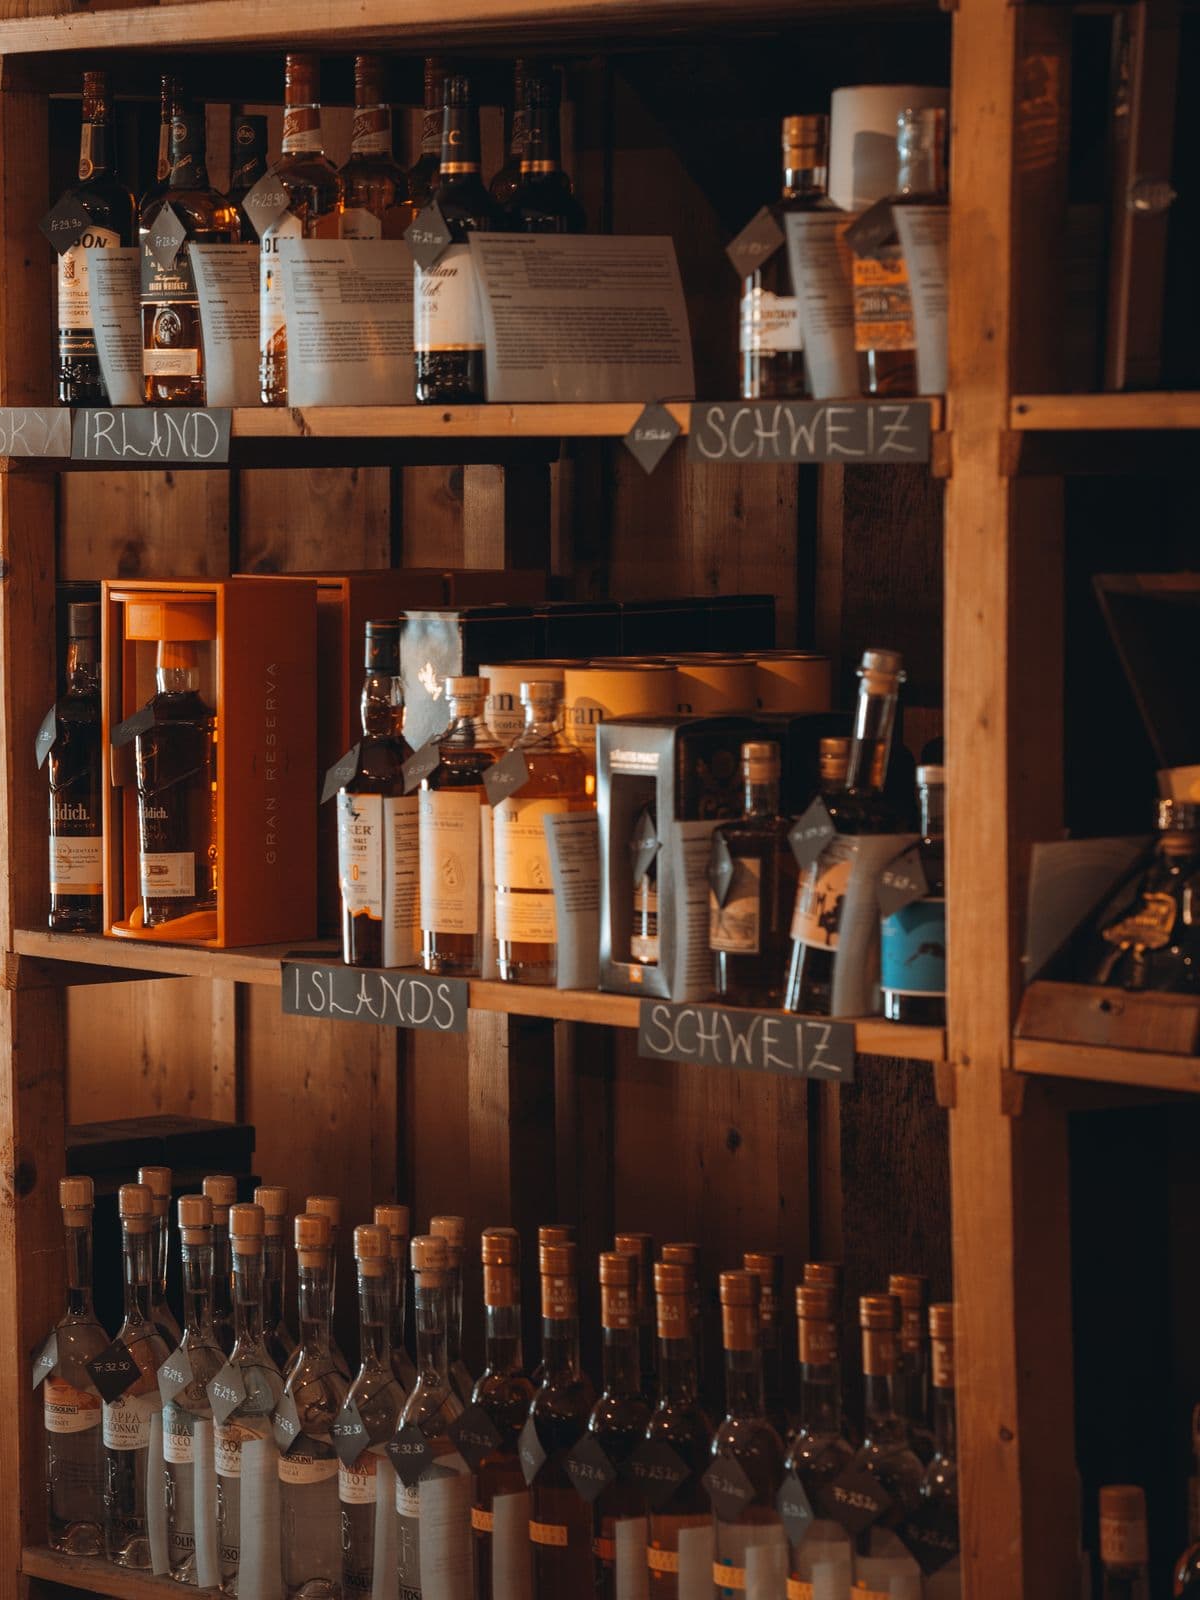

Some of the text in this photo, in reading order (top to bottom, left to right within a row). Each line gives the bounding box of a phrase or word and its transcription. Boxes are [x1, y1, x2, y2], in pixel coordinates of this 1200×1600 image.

[85, 410, 219, 458] IRLAND
[696, 404, 917, 459] SCHWEIZ
[266, 663, 277, 864] GRAN RESERVA
[294, 967, 455, 1030] ISLANDS
[644, 1004, 842, 1073] SCHWEIZ
